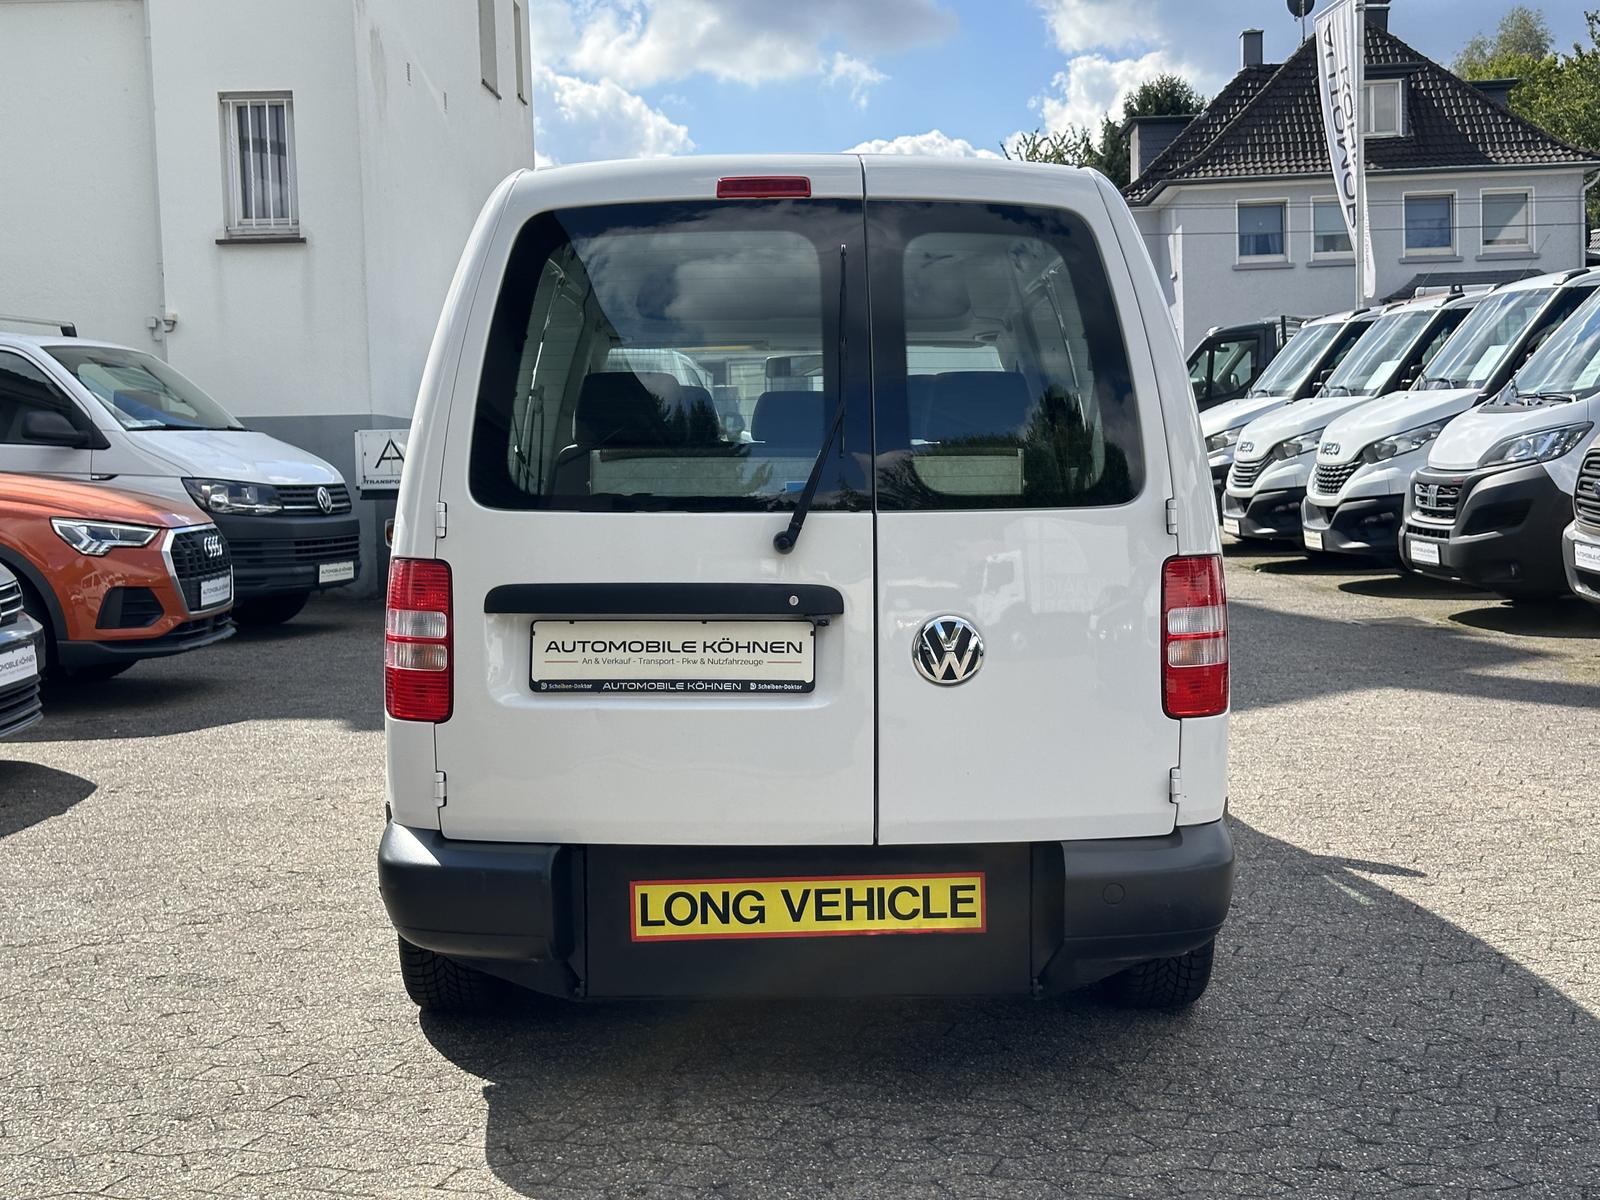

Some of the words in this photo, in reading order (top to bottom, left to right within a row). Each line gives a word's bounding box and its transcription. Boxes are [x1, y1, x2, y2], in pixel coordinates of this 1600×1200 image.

[545, 640, 697, 653] AUTOMOBILE
[702, 637, 803, 654] KÖHNEN
[582, 657, 593, 665] An
[594, 657, 600, 665] &
[601, 657, 632, 665] Verkauf
[638, 657, 675, 667] Transport
[682, 657, 698, 665] Pkw
[707, 657, 764, 667] Nutzfahrzeuge
[602, 682, 684, 690] AUTOMOBILE
[687, 681, 742, 690] KÖHNEN
[640, 890, 766, 927] LONG
[781, 885, 977, 922] VEHICLE
